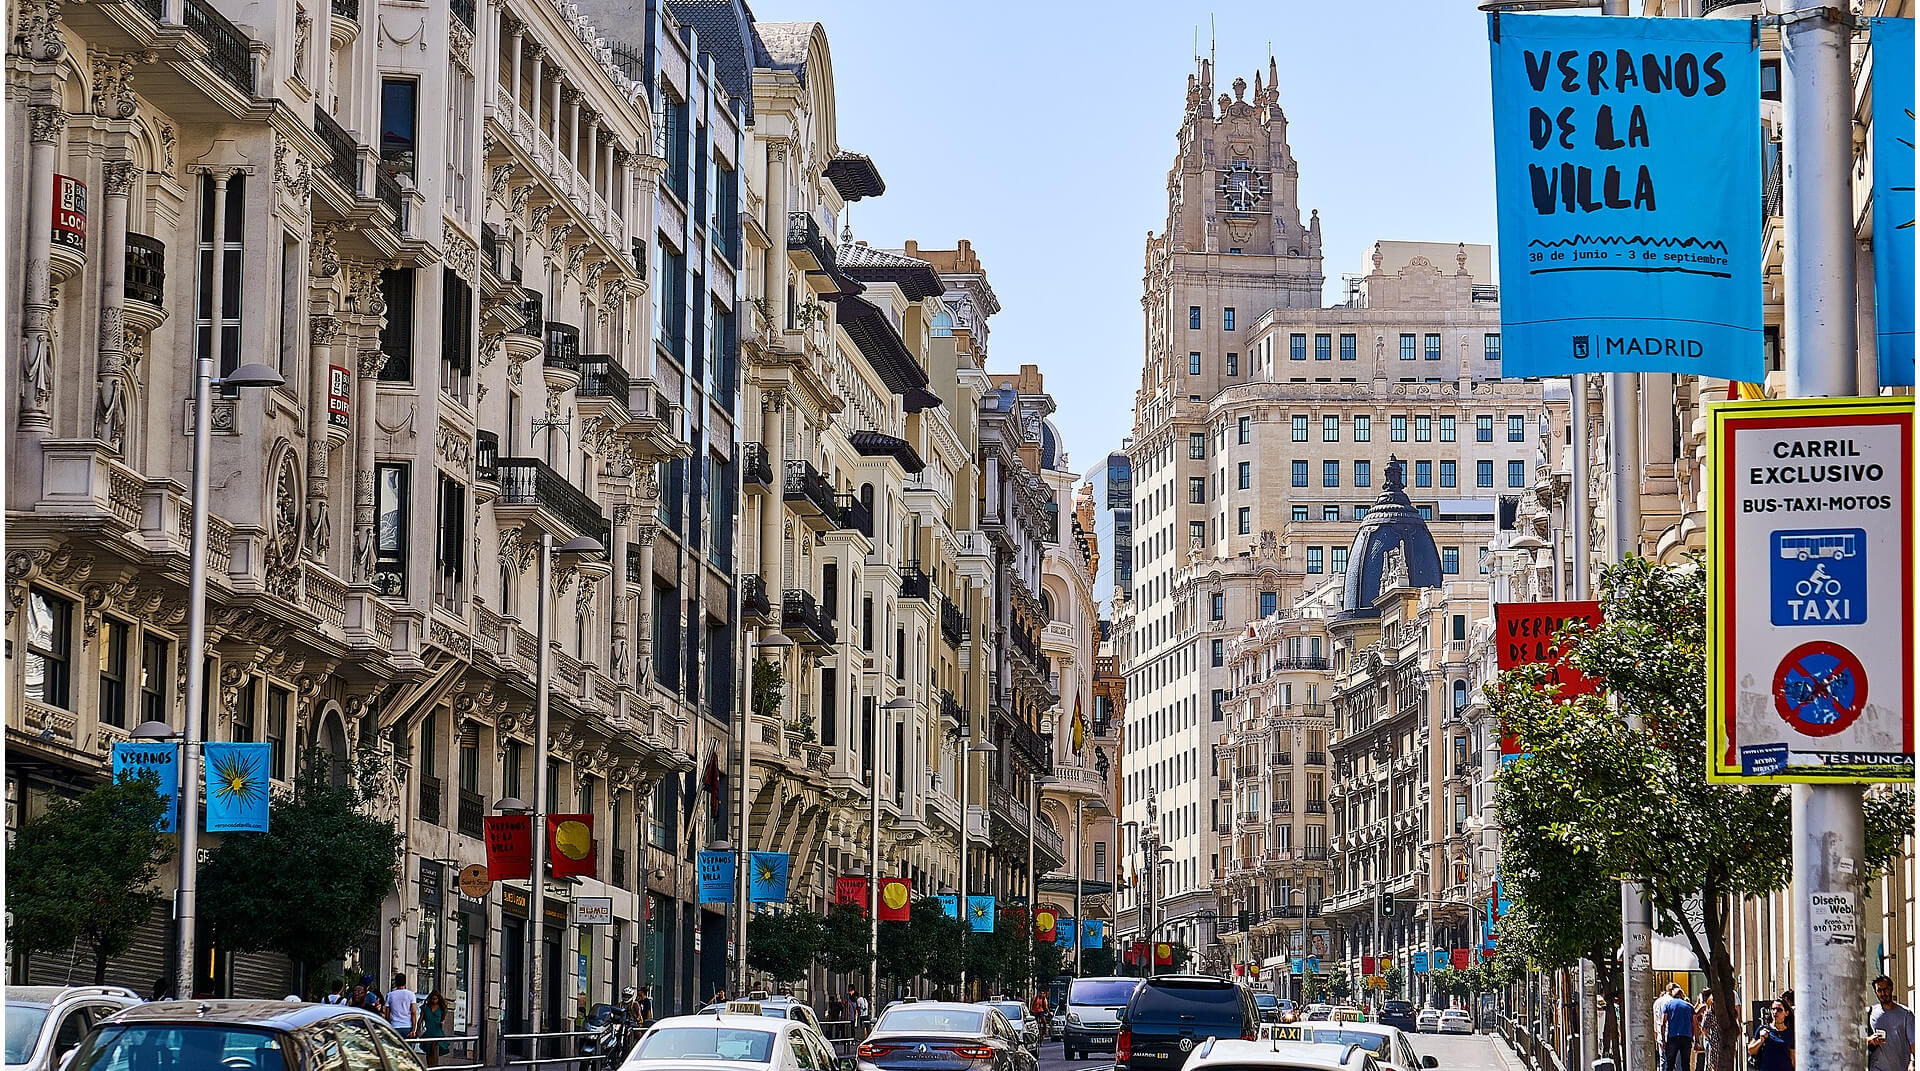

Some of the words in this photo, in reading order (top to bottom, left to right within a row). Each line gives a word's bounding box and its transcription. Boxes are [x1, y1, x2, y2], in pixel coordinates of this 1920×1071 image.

[1524, 49, 1727, 97] VERANOS
[1529, 106, 1576, 151] DE
[1595, 104, 1650, 150] LA
[1528, 162, 1657, 215] VILLA
[1529, 252, 1544, 262] 30
[1550, 250, 1565, 260] de
[1572, 249, 1608, 261] junio
[1628, 250, 1636, 259] 3
[1642, 251, 1657, 260] de
[1663, 252, 1728, 266] septiembre
[1606, 337, 1704, 358] MADRID
[1773, 439, 1861, 459] CARRIL
[1749, 464, 1884, 485] EXCLUSIVO
[1742, 495, 1892, 514] BUS-TAXI-MOTOS
[1788, 599, 1850, 621] TAXI
[1510, 643, 1528, 662] DE
[121, 751, 172, 765] VERANOS
[1854, 755, 1914, 766] NUNCA
[1812, 896, 1847, 905] Diseño
[1813, 925, 1827, 933] 910
[1343, 1012, 1358, 1021] TAXI
[1273, 1026, 1301, 1040] TAXI
